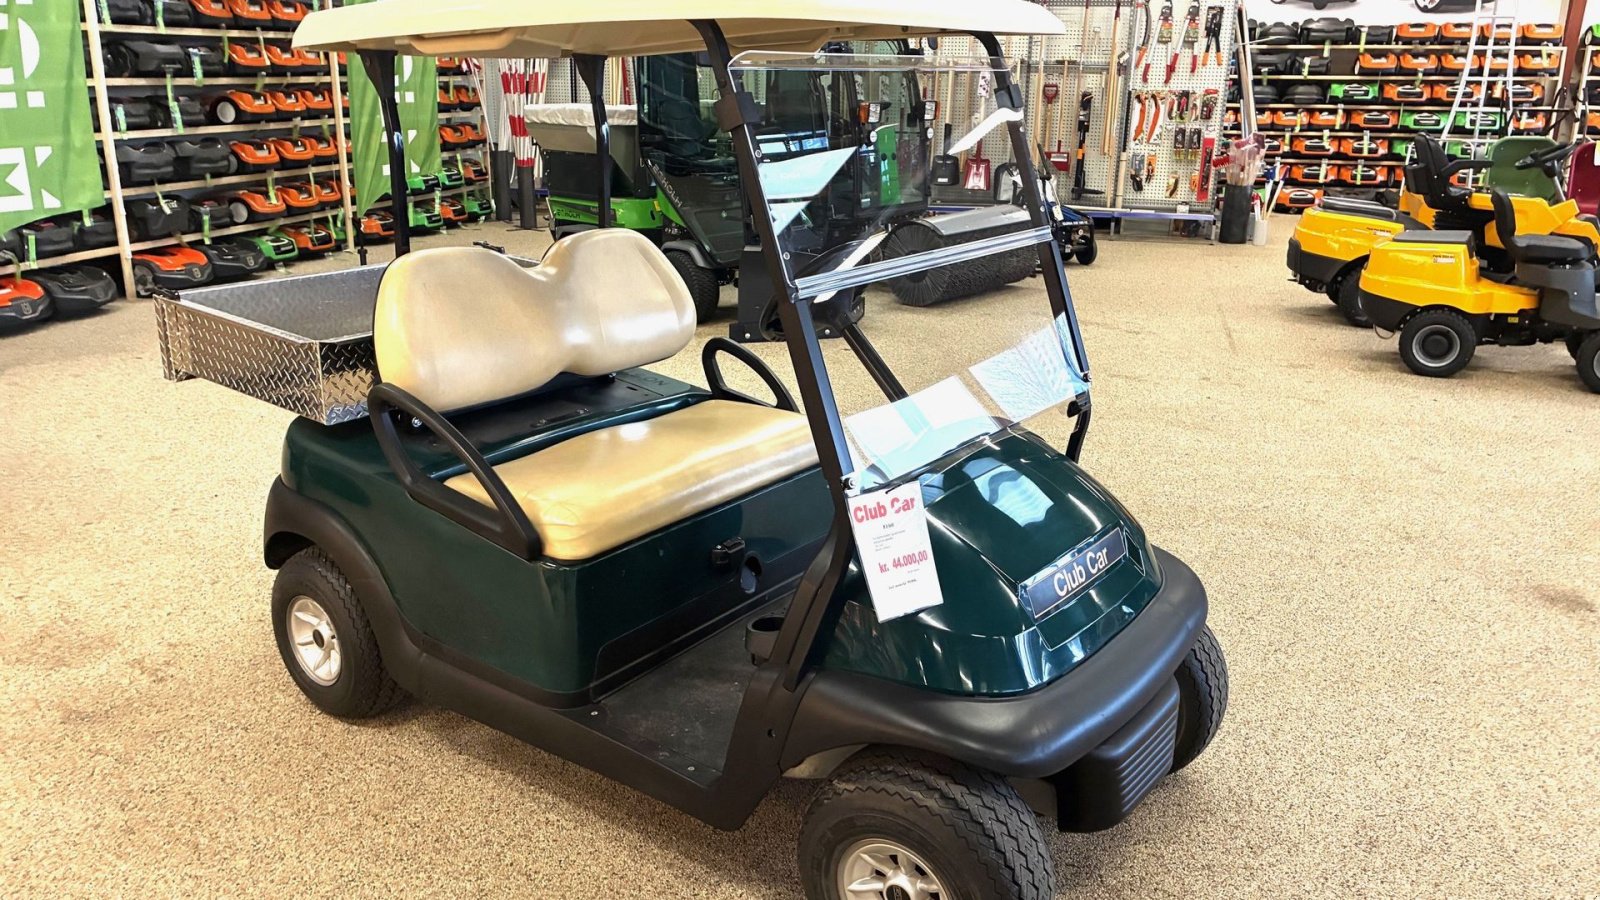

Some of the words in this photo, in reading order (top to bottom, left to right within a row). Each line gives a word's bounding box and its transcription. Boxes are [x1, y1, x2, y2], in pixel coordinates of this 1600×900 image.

[853, 501, 887, 523] Club
[890, 497, 915, 514] Car
[878, 562, 890, 573] kr.
[892, 550, 928, 569] 44.000,00
[1053, 562, 1086, 597] Club
[1086, 547, 1108, 574] Car
